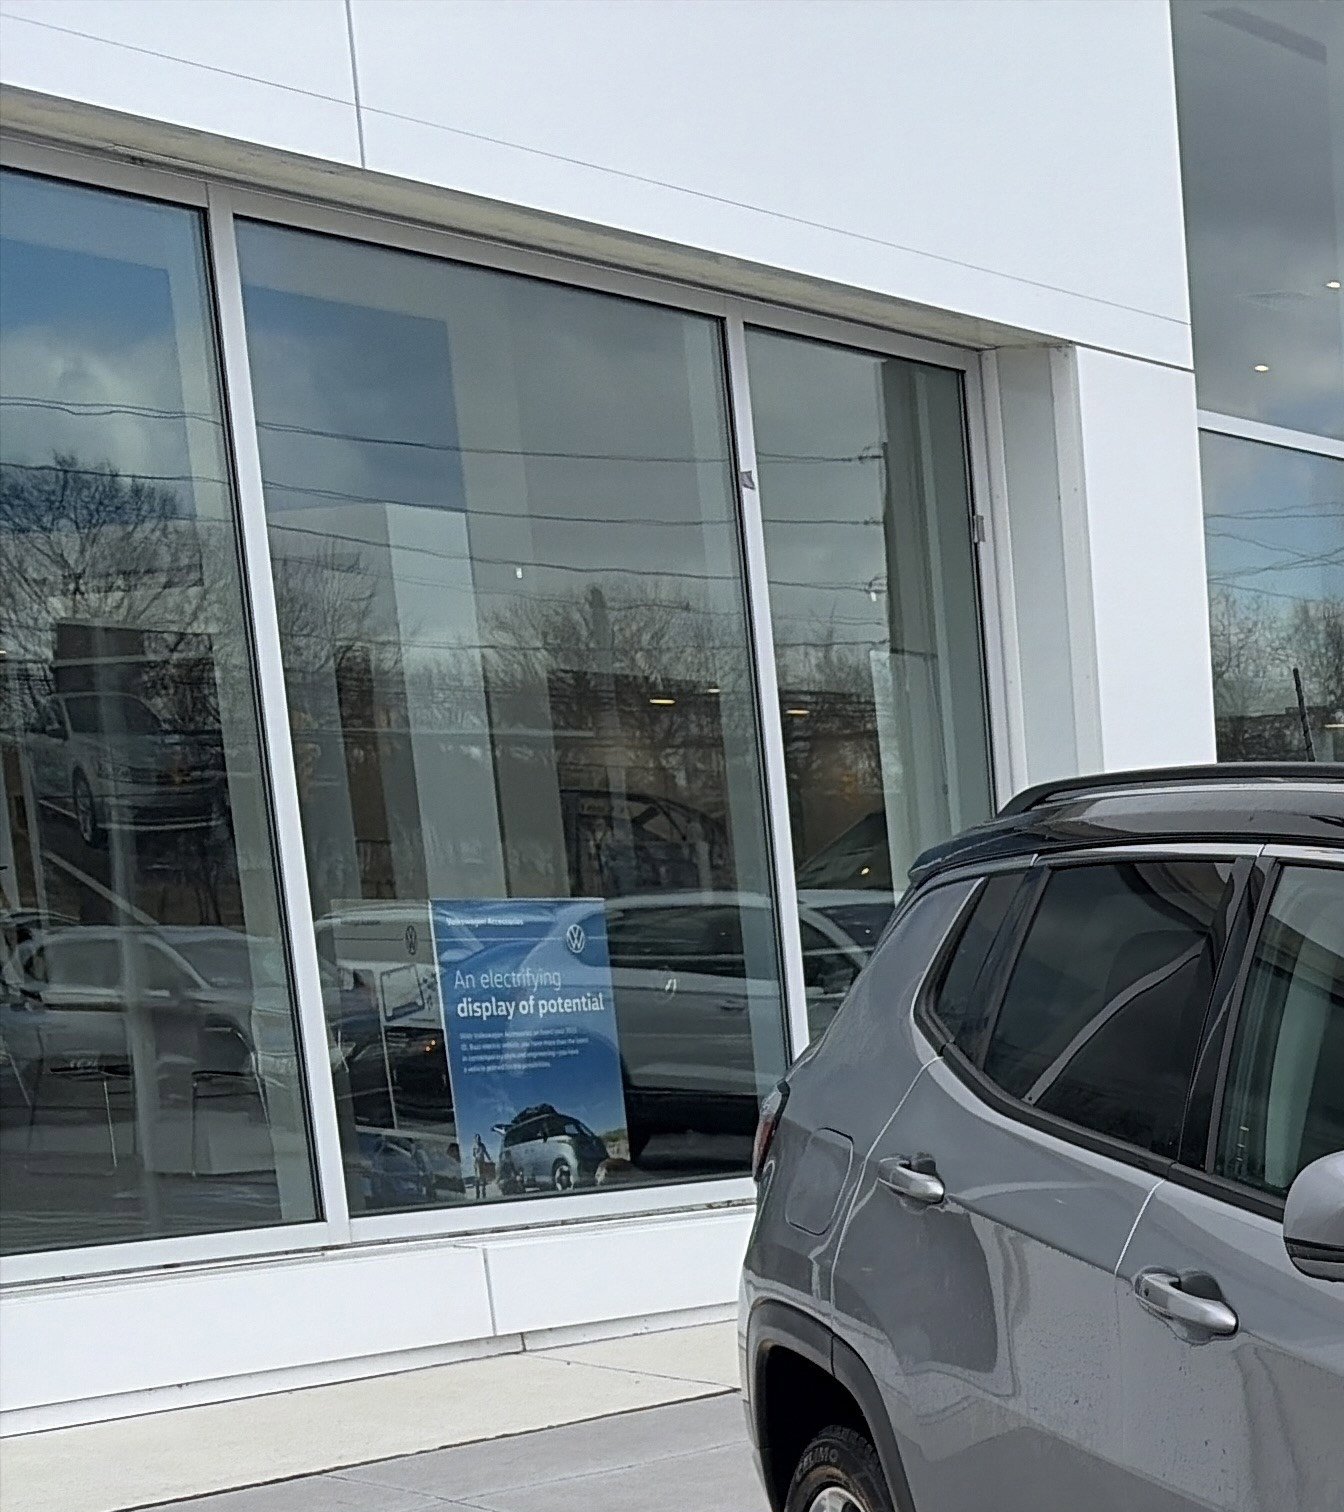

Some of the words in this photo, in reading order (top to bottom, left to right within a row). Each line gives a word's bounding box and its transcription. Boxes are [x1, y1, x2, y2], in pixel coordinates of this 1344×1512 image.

[454, 970, 476, 989] An
[480, 968, 562, 992] electrifying
[457, 996, 515, 1020] display
[519, 994, 534, 1014] of
[538, 992, 605, 1018] potential
